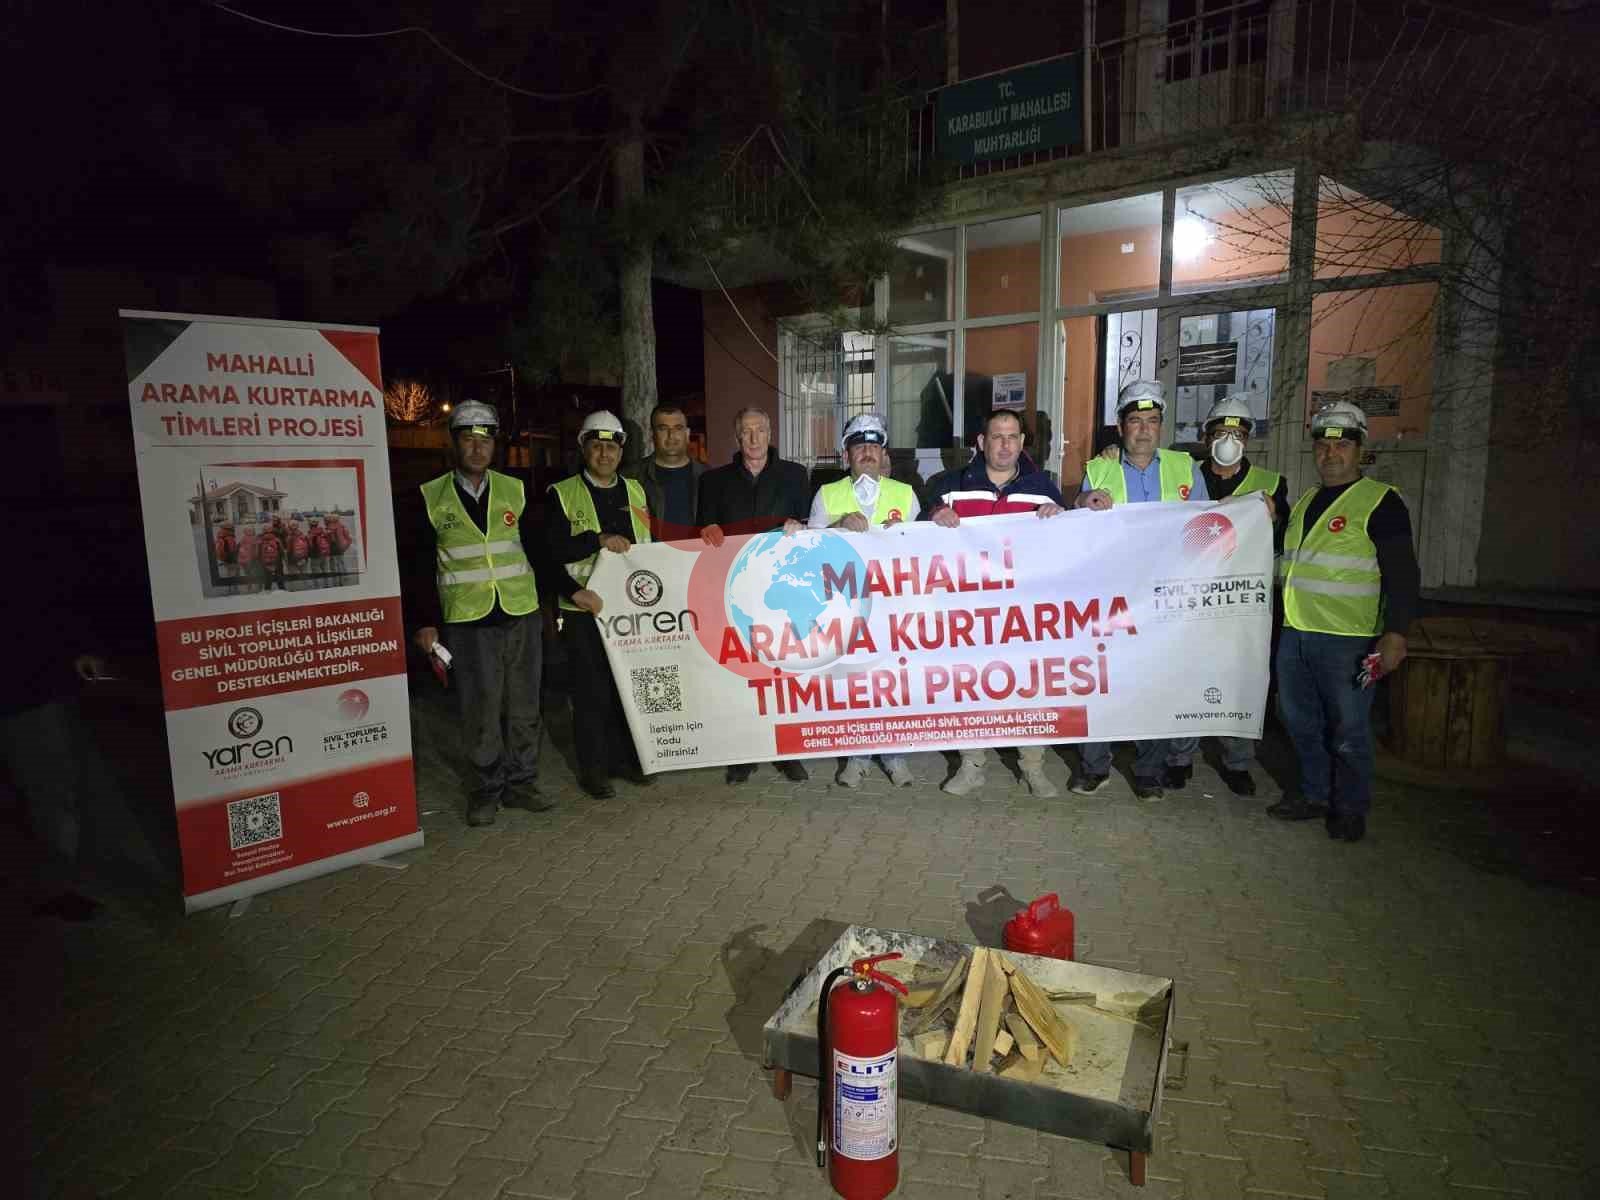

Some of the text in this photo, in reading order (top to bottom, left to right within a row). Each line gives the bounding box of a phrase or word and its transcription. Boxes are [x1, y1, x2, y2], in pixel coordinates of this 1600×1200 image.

[948, 87, 1072, 136] KARABULUT MAHALLESİ
[974, 124, 1041, 155] MUHTARLIĞI
[206, 352, 315, 377] MAHALLİ
[141, 383, 376, 409] ARAMA KURTARMA
[160, 411, 364, 437] TİMLERİ PROJESİ
[822, 537, 1015, 600] MAHALLİ
[1192, 579, 1265, 595] TOPLUMLA
[181, 607, 384, 645] BU PROJE İÇİŞLERİ BAKANLIĞI
[719, 596, 1138, 665] ARAMA KURTARMA
[199, 627, 373, 660] SİVİL TOPLUMLA İLİŞKİLER
[171, 640, 397, 682] GENEL MÜDÜRLÜĞÜ TARAFINDAN
[217, 661, 364, 693] DESTEKLENMEKTEDİR.
[748, 643, 1109, 716] TİMLERİ PROJESİ
[801, 711, 1059, 737] BU PROJE İÇİŞLERİ BAKANLIĞI SİVİL TOPLUMLA İLİŞKİLER
[1175, 711, 1253, 721] www.yaren.org.tr
[345, 725, 387, 739] TOPLUMLA
[657, 736, 681, 746] Kodu
[803, 723, 1058, 749] GENEL MÜDÜRLÜĞÜ TARAFINDAN DESTEKLENMEKTEDİR.
[327, 805, 397, 829] www.yaren.org.tr
